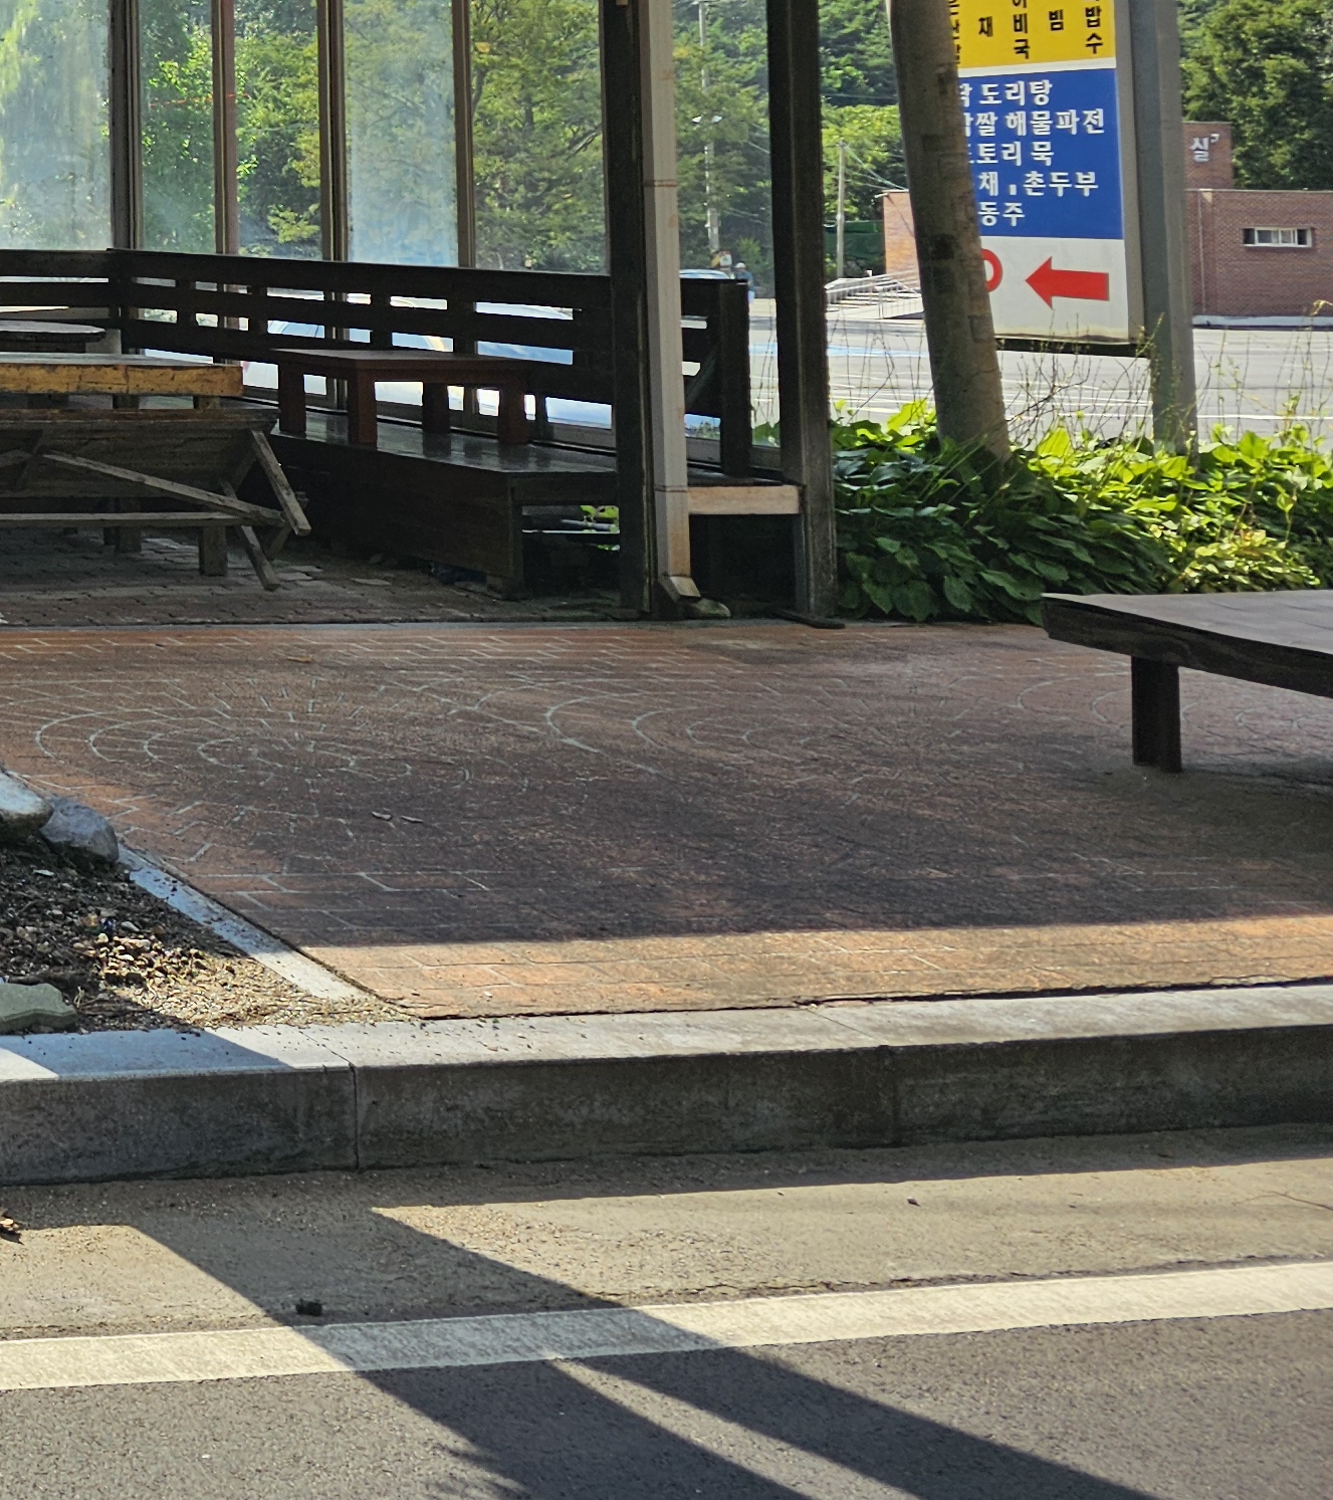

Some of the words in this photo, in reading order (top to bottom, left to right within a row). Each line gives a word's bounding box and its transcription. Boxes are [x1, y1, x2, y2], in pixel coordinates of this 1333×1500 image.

[1005, 107, 1105, 137] 해물파전
[969, 141, 1022, 167] 토리
[1030, 141, 1055, 167] 묵
[978, 171, 1000, 197] 채
[1023, 170, 1099, 198] 촌두부
[978, 201, 1026, 227] 동주
